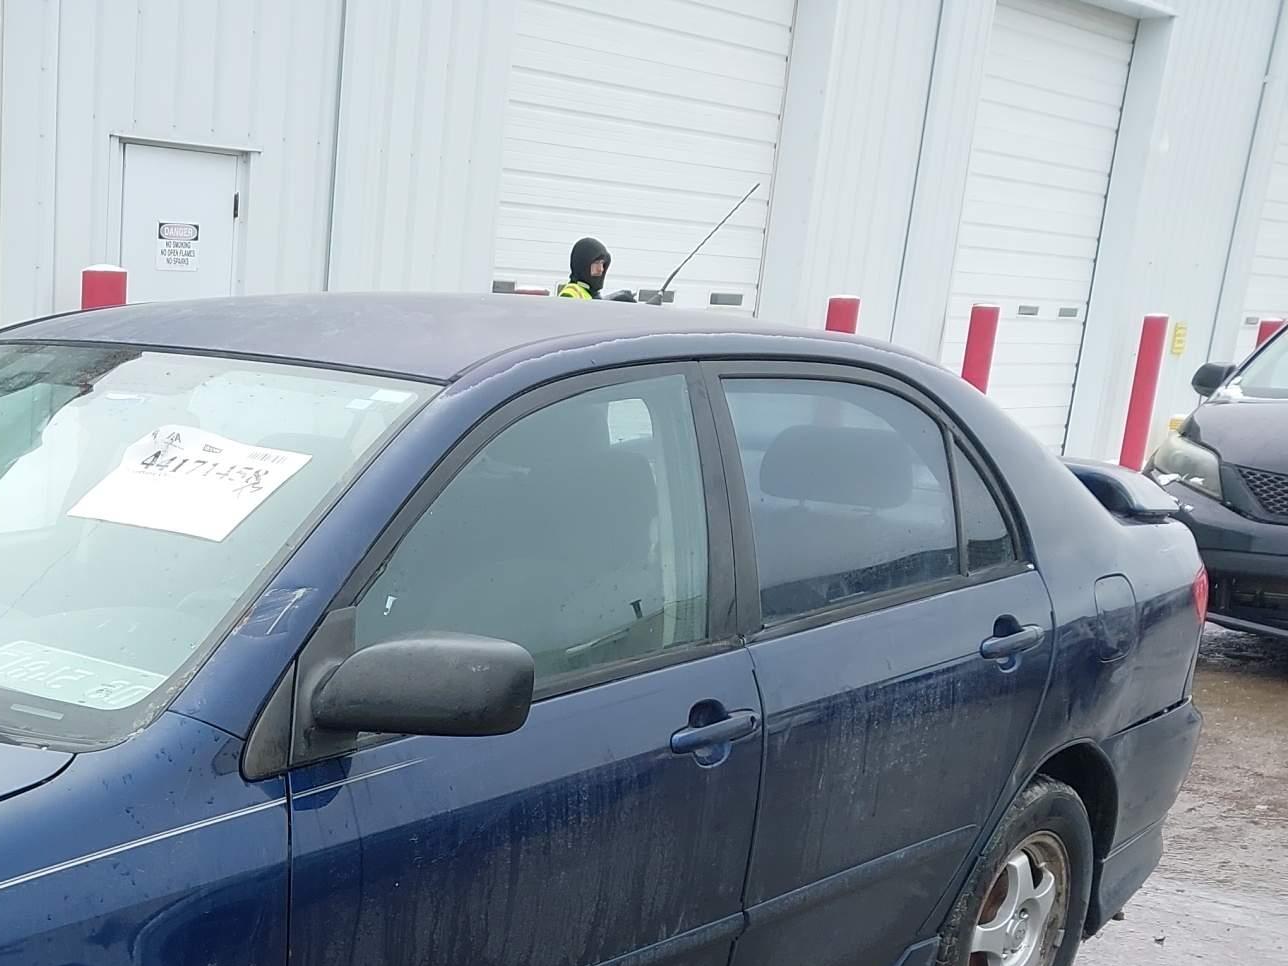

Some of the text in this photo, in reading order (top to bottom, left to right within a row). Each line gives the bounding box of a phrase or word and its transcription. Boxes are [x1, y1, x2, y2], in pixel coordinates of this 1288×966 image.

[164, 226, 193, 237] DANGER
[172, 241, 191, 249] SMOKING
[167, 249, 179, 257] OPEN
[179, 249, 196, 257] FLAMES
[173, 257, 189, 265] SPARKS
[141, 450, 269, 483] 44171458
